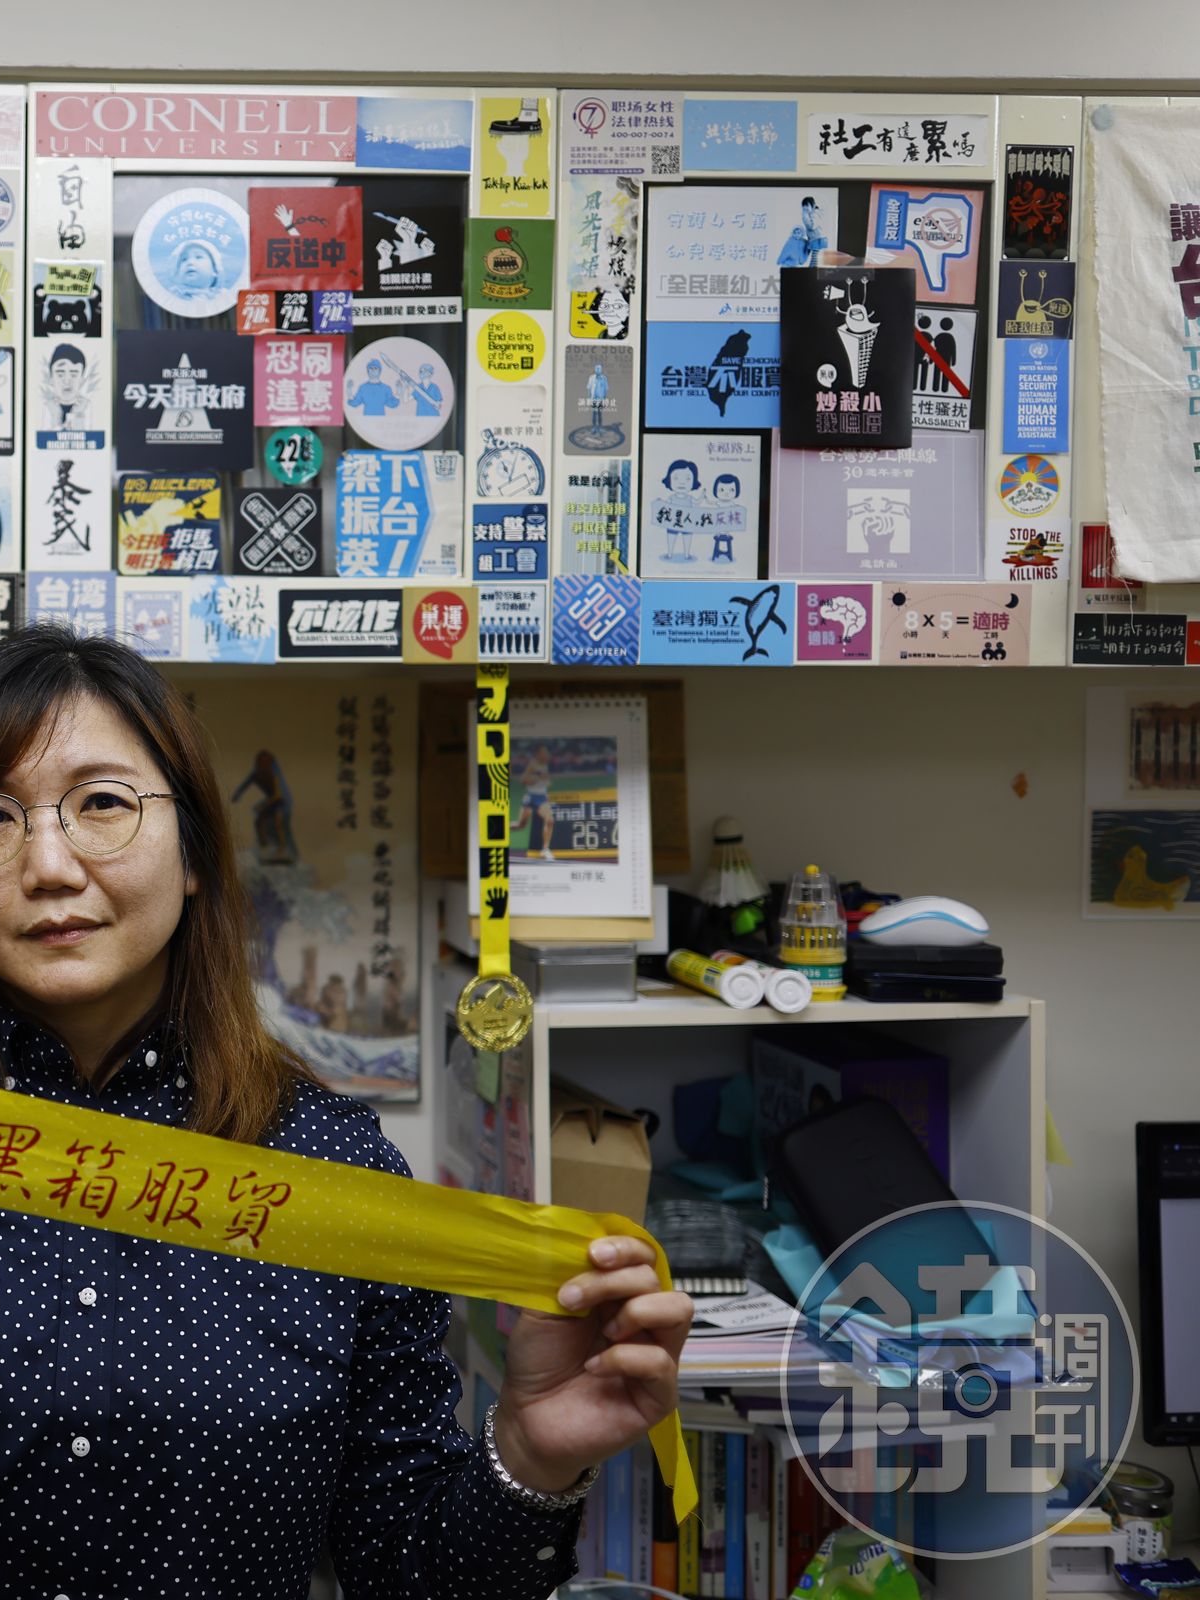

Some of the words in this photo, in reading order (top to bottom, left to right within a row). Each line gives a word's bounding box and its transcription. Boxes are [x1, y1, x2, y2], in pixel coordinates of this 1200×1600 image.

[611, 101, 674, 113] 职场女性
[48, 96, 351, 136] CORNELL
[611, 115, 674, 128] 法律热线
[50, 136, 349, 158] UNIVERSITY
[267, 238, 346, 269] 反送中
[488, 323, 503, 331] the
[488, 332, 506, 341] End
[508, 332, 515, 341] is
[517, 332, 532, 341] the
[488, 342, 534, 352] Beginning
[266, 341, 333, 377] 恐同
[488, 352, 498, 360] of
[500, 352, 514, 360] the
[488, 361, 520, 371] Future
[1019, 374, 1042, 382] PEACE
[1019, 382, 1057, 391] SECURITY
[123, 383, 246, 409] 今天拆政府
[266, 380, 333, 412] 違憲
[816, 391, 882, 412] 炒殺小
[1018, 405, 1057, 415] HUMAN
[1018, 415, 1057, 425] RIGHTS
[150, 478, 216, 491] NUCLEAR
[341, 454, 381, 577] 梁振英
[1010, 528, 1036, 542] STOP
[1044, 530, 1061, 543] THE
[1009, 567, 1058, 581] KILLINGS
[808, 593, 818, 607] 8
[653, 609, 740, 628] 臺灣獨立
[808, 612, 818, 626] 5
[905, 611, 919, 629] 8
[939, 612, 953, 629] 5
[973, 611, 1010, 631] 適時
[295, 633, 328, 642] AGAINST
[368, 633, 396, 642] POWER
[942, 631, 950, 639] 天
[983, 631, 998, 639] 工時
[585, 647, 627, 656] CITIZEN
